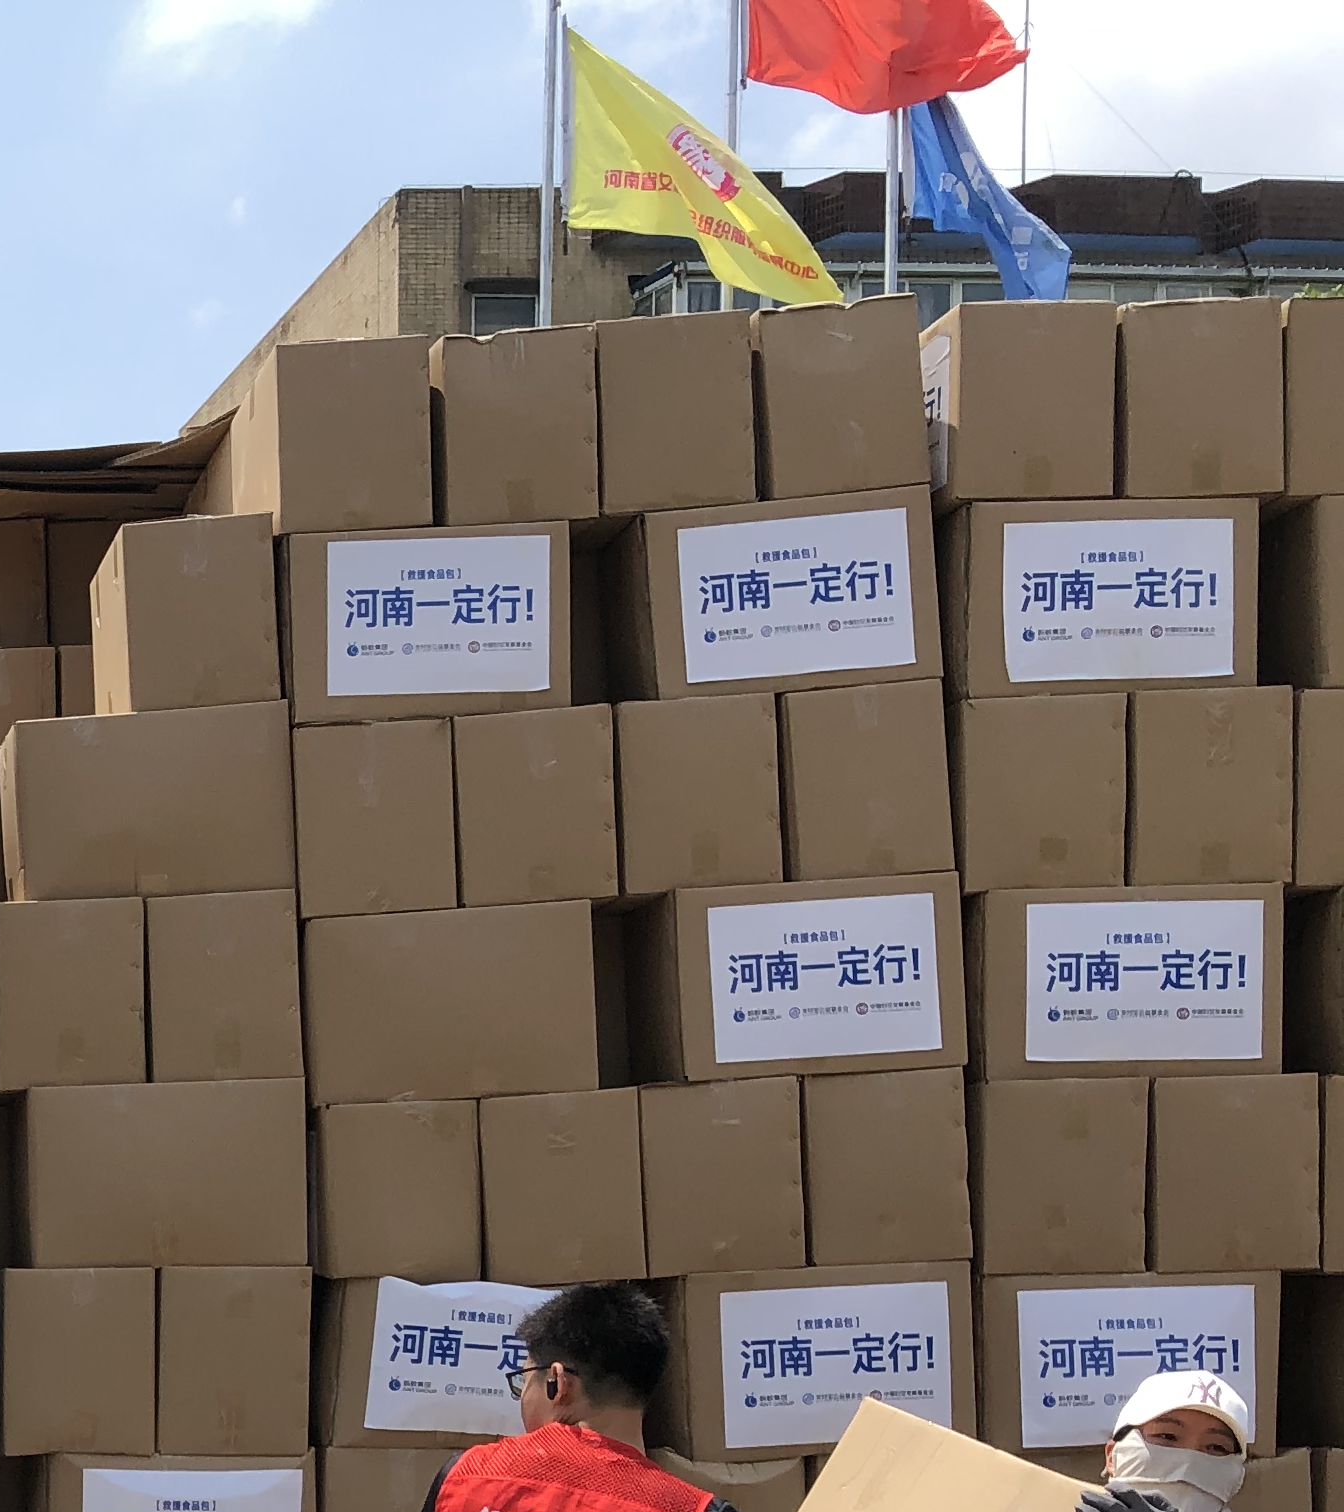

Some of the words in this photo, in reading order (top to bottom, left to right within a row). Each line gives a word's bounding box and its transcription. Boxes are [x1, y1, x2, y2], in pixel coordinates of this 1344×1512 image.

[344, 583, 533, 628] 河南一定行!
[698, 559, 894, 613] 河南一定行!
[1020, 566, 1217, 612] 河南一定行!
[727, 943, 920, 994] 河南一定行!
[1045, 948, 1246, 993] 河南一定行!
[739, 1330, 934, 1379] 河南一定行!
